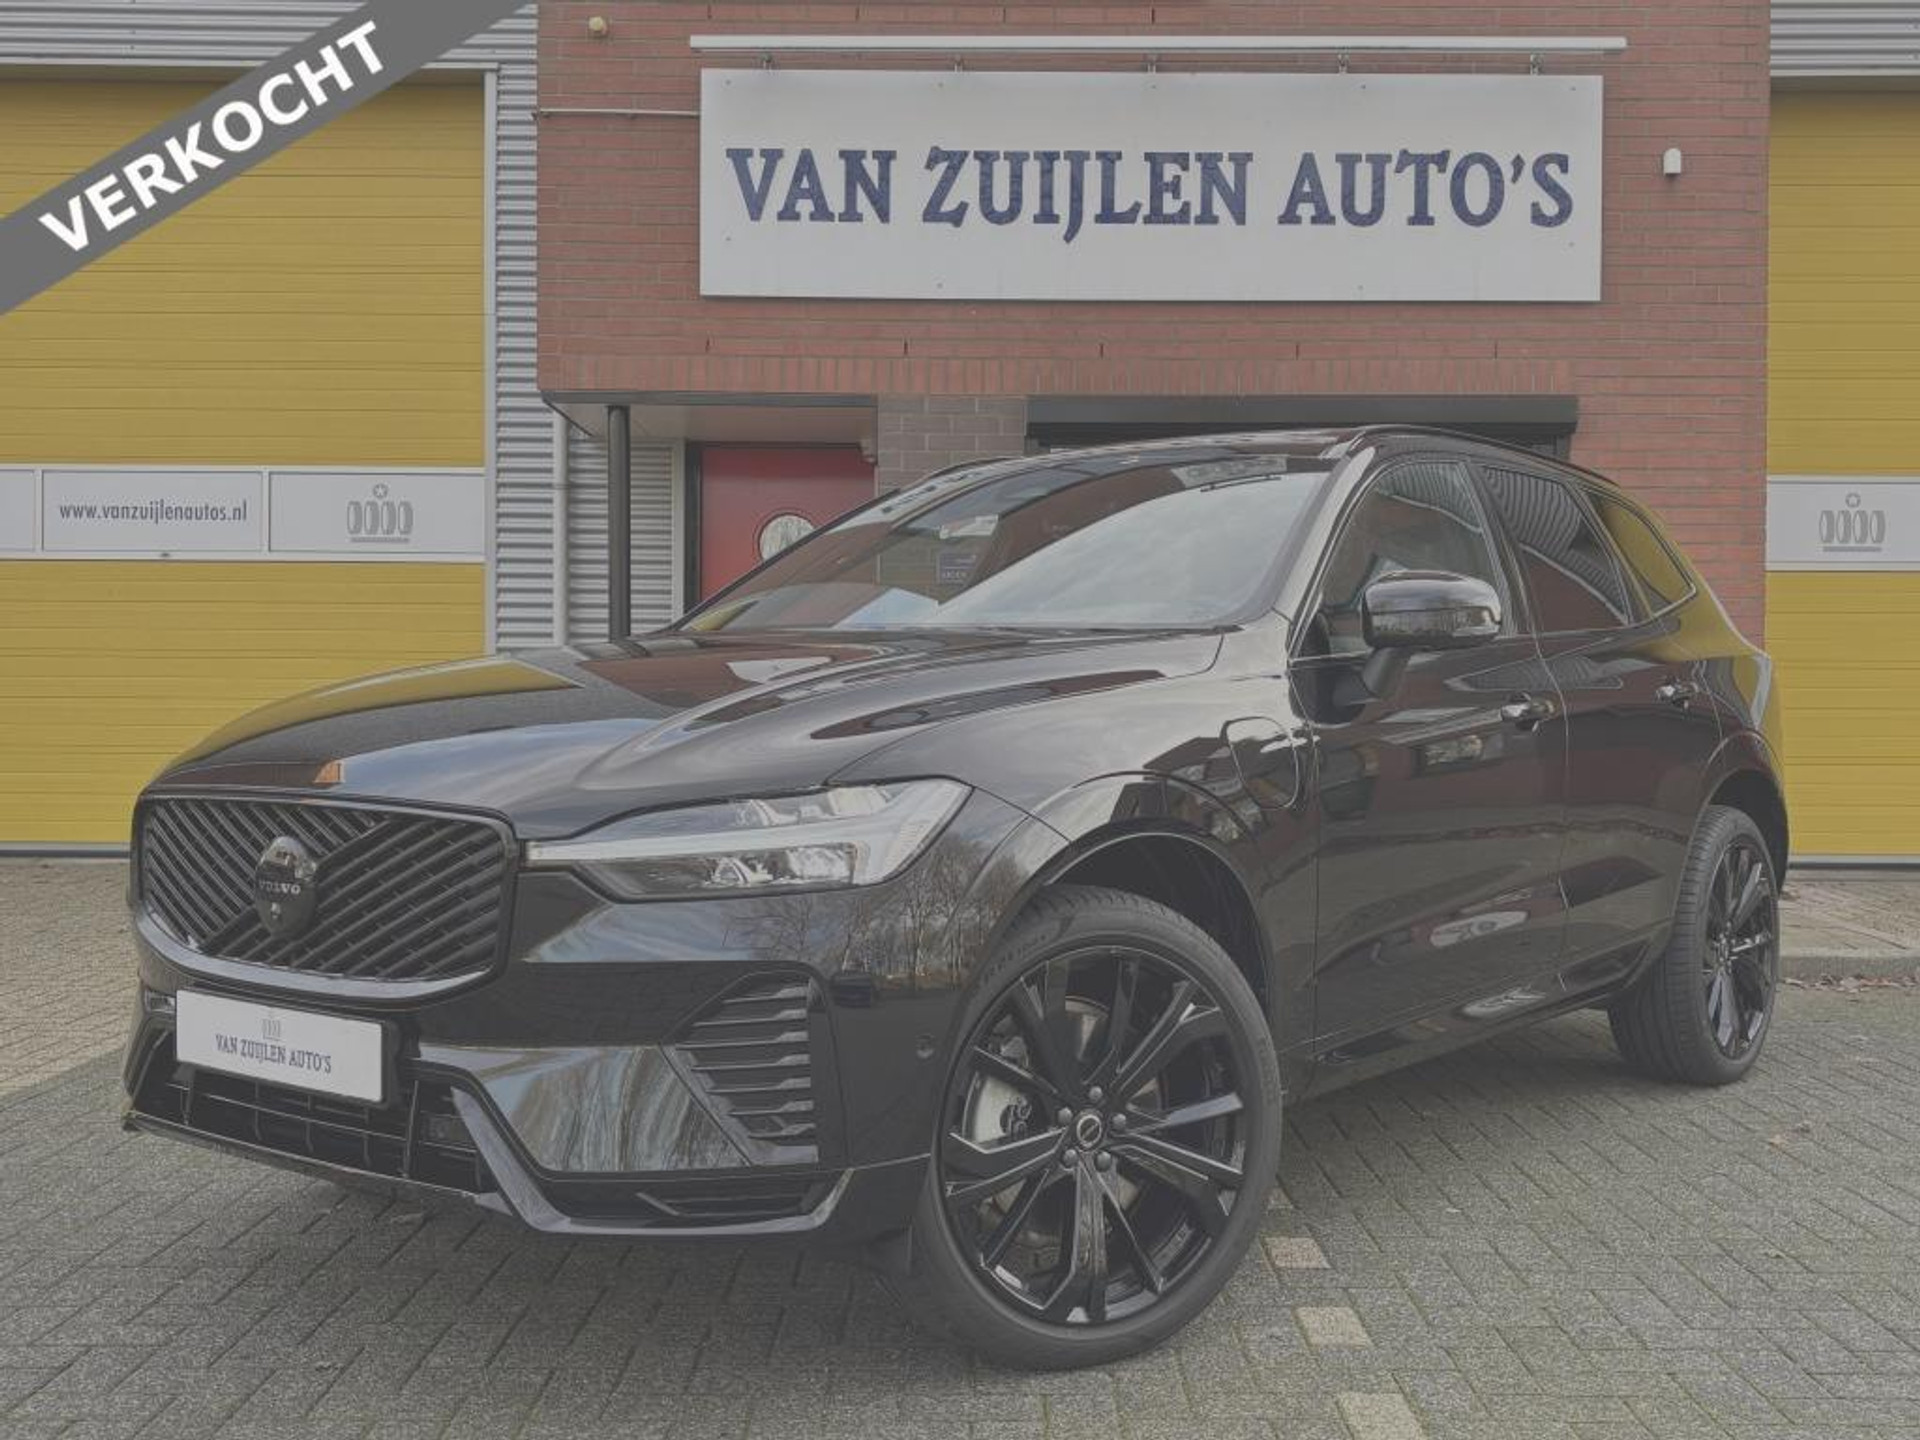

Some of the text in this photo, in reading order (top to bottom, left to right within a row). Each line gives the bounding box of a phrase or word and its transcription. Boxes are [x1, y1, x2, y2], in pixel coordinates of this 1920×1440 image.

[725, 145, 1574, 245] VAN ZUIJLEN AUTO'S
[59, 498, 248, 525] www.vanzuijlenautos.nl
[259, 881, 301, 895] VOLVO
[215, 1034, 333, 1075] VAN ZUIJLEN AUTO'S
